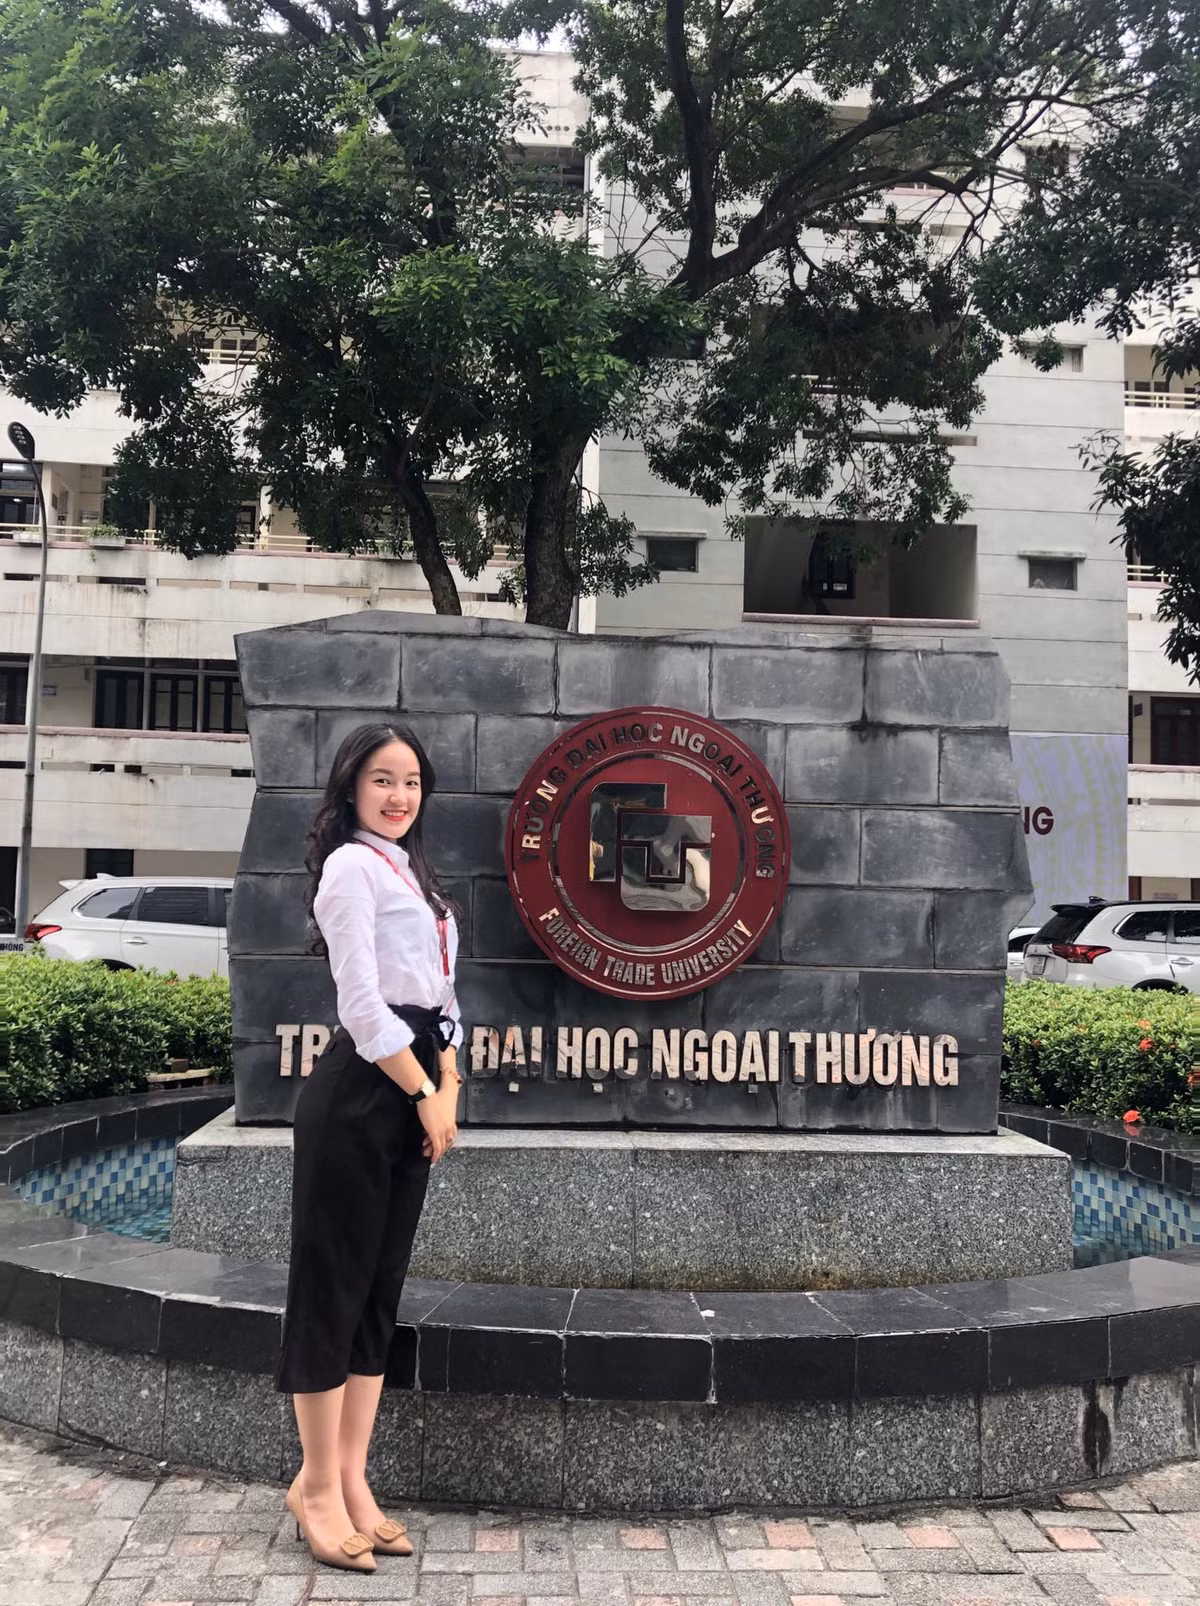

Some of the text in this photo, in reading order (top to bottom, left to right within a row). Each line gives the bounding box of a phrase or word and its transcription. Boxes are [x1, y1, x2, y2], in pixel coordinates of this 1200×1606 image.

[613, 722, 663, 747] HỌC
[539, 907, 753, 986] FOREIGN TRADE UNIVERSITY
[470, 1025, 959, 1093] ĐẠI HỌC NGOẠI THƯƠNG
